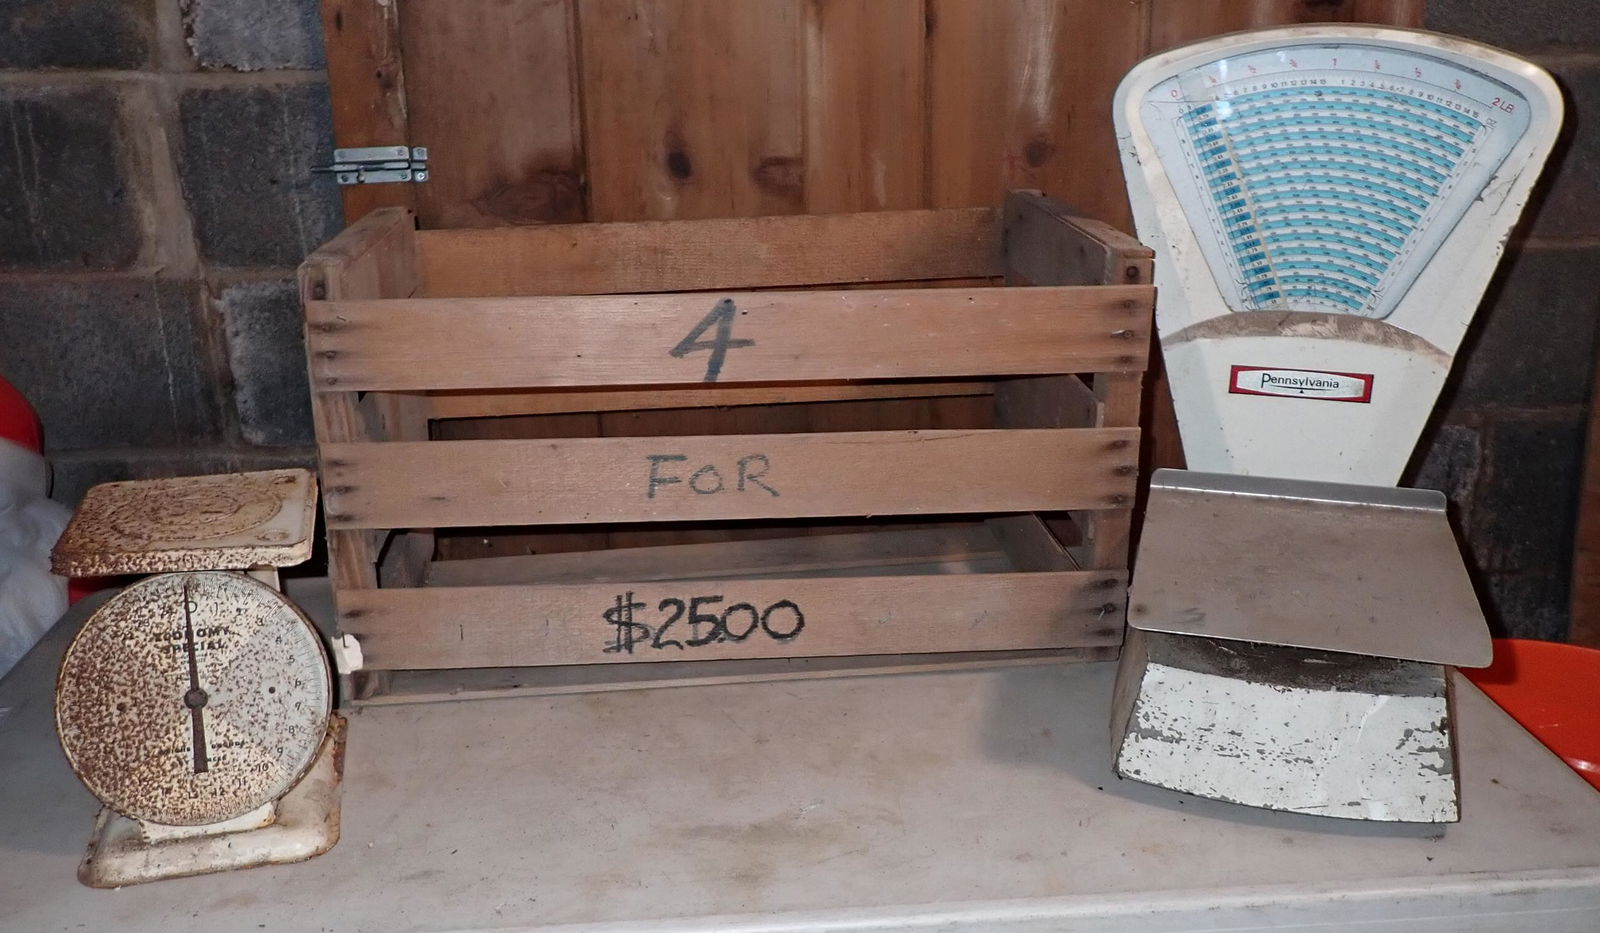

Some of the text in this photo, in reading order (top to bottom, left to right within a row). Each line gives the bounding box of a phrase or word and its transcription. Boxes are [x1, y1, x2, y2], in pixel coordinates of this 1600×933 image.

[669, 298, 755, 383] 4
[1260, 372, 1340, 389] Pennsylvania
[646, 453, 780, 498] FOR
